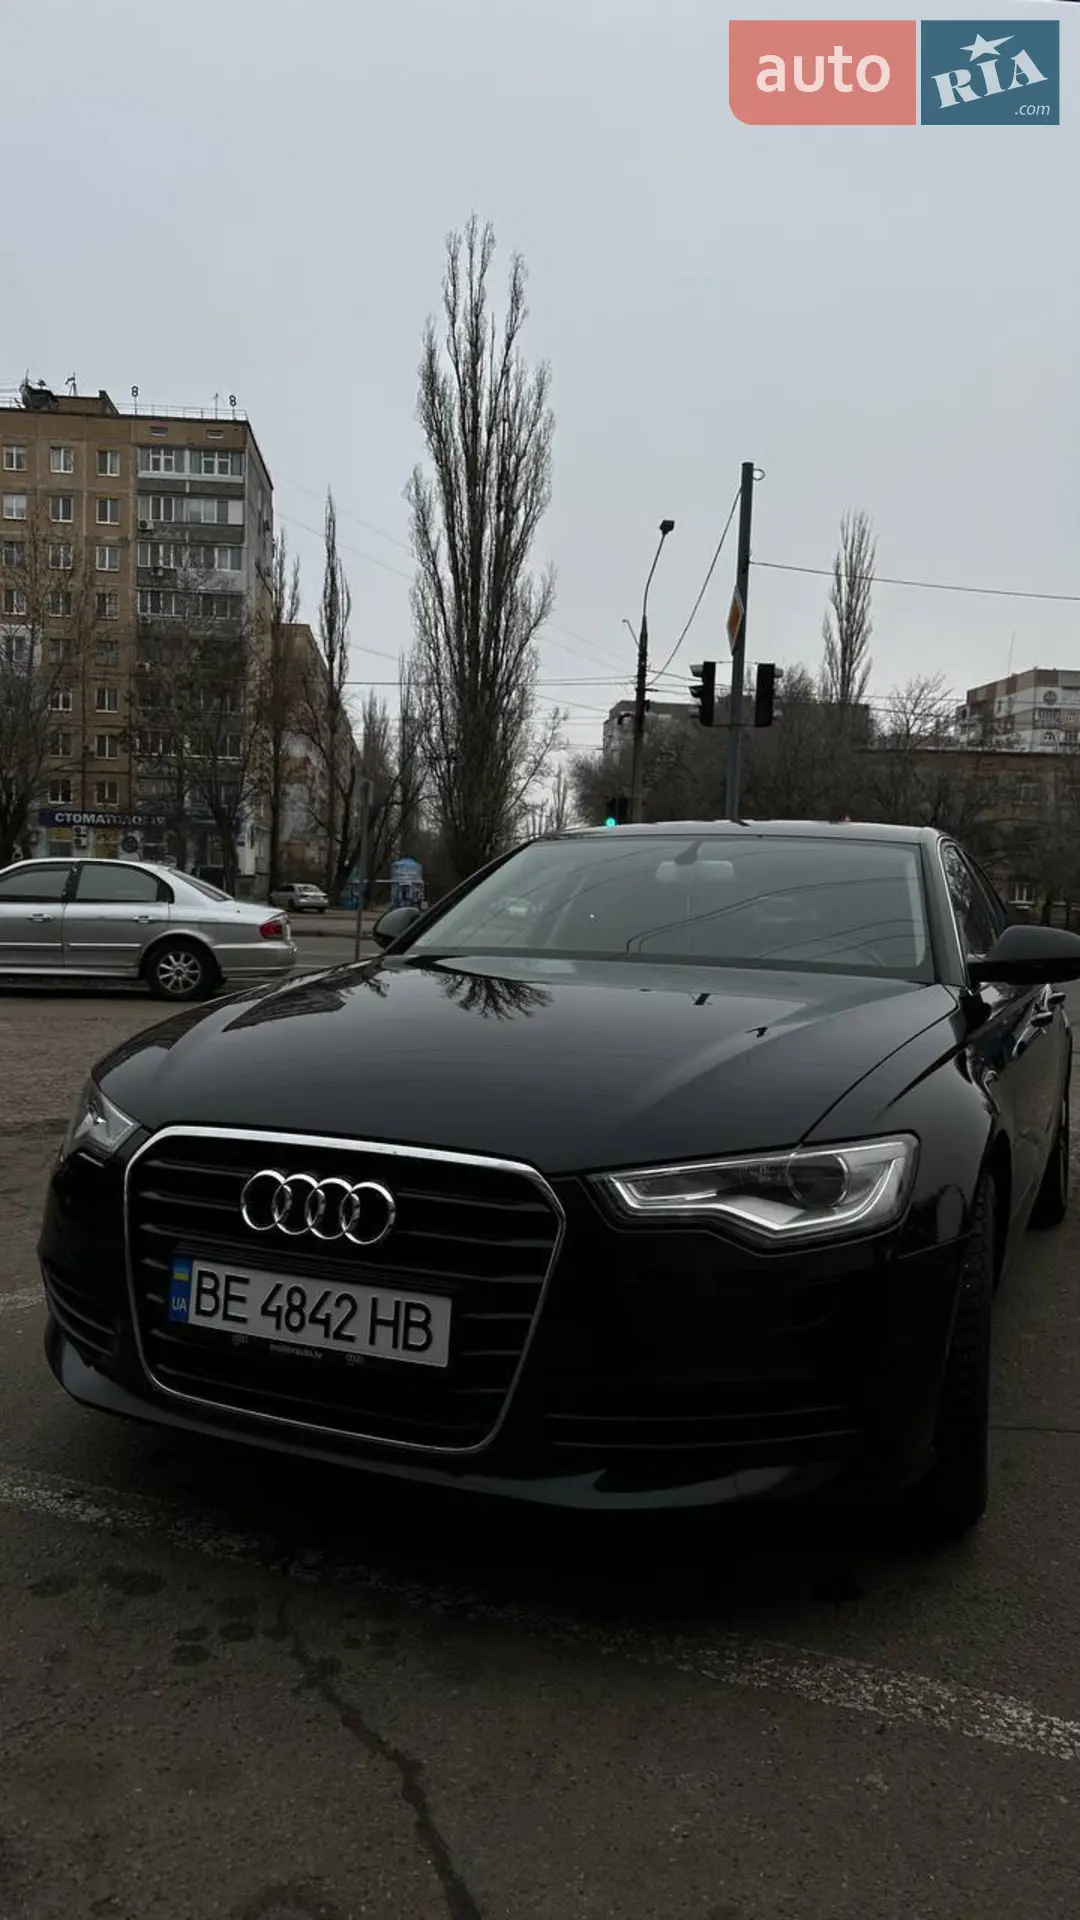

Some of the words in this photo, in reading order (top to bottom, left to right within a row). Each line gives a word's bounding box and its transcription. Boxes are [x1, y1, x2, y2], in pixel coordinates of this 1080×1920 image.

[171, 1296, 187, 1312] UA
[194, 1269, 251, 1324] BE
[260, 1281, 359, 1342] 4842
[368, 1296, 434, 1352] HB
